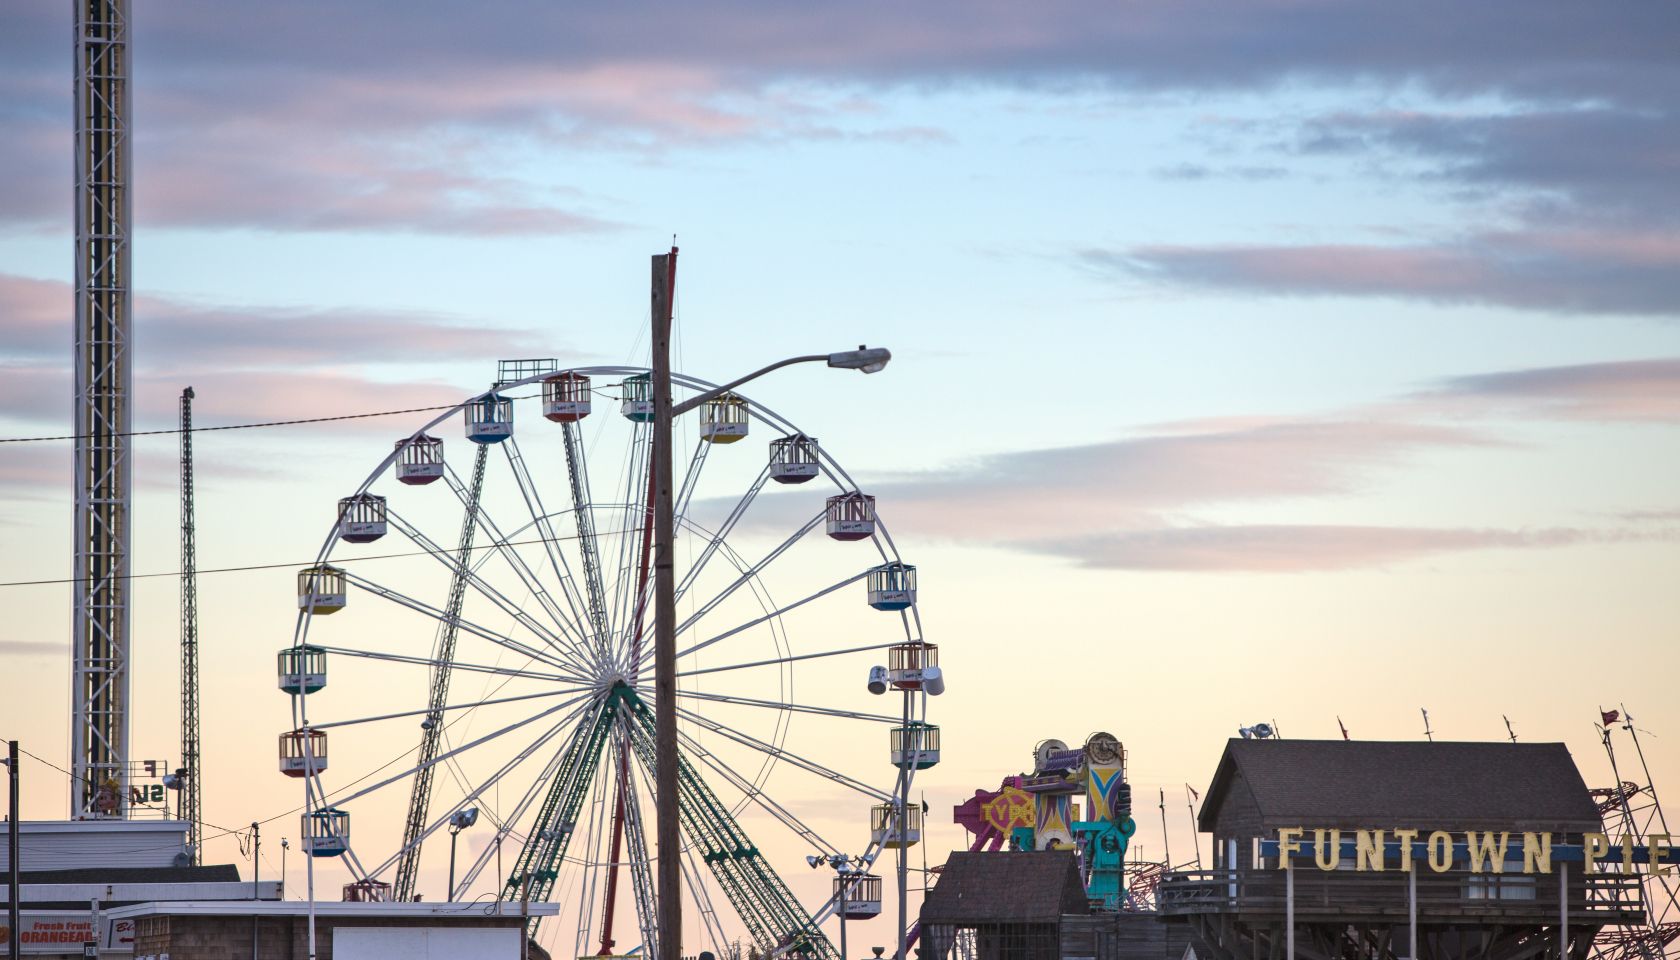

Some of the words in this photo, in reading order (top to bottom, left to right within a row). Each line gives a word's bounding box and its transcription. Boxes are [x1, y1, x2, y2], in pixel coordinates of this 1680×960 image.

[981, 803, 1034, 821] TYPH
[1276, 825, 1553, 874] FUNTOWN
[1583, 831, 1671, 878] PIE
[33, 921, 65, 931] Fresh
[66, 921, 92, 931] Fruit
[20, 931, 103, 944] ORANGEAD
